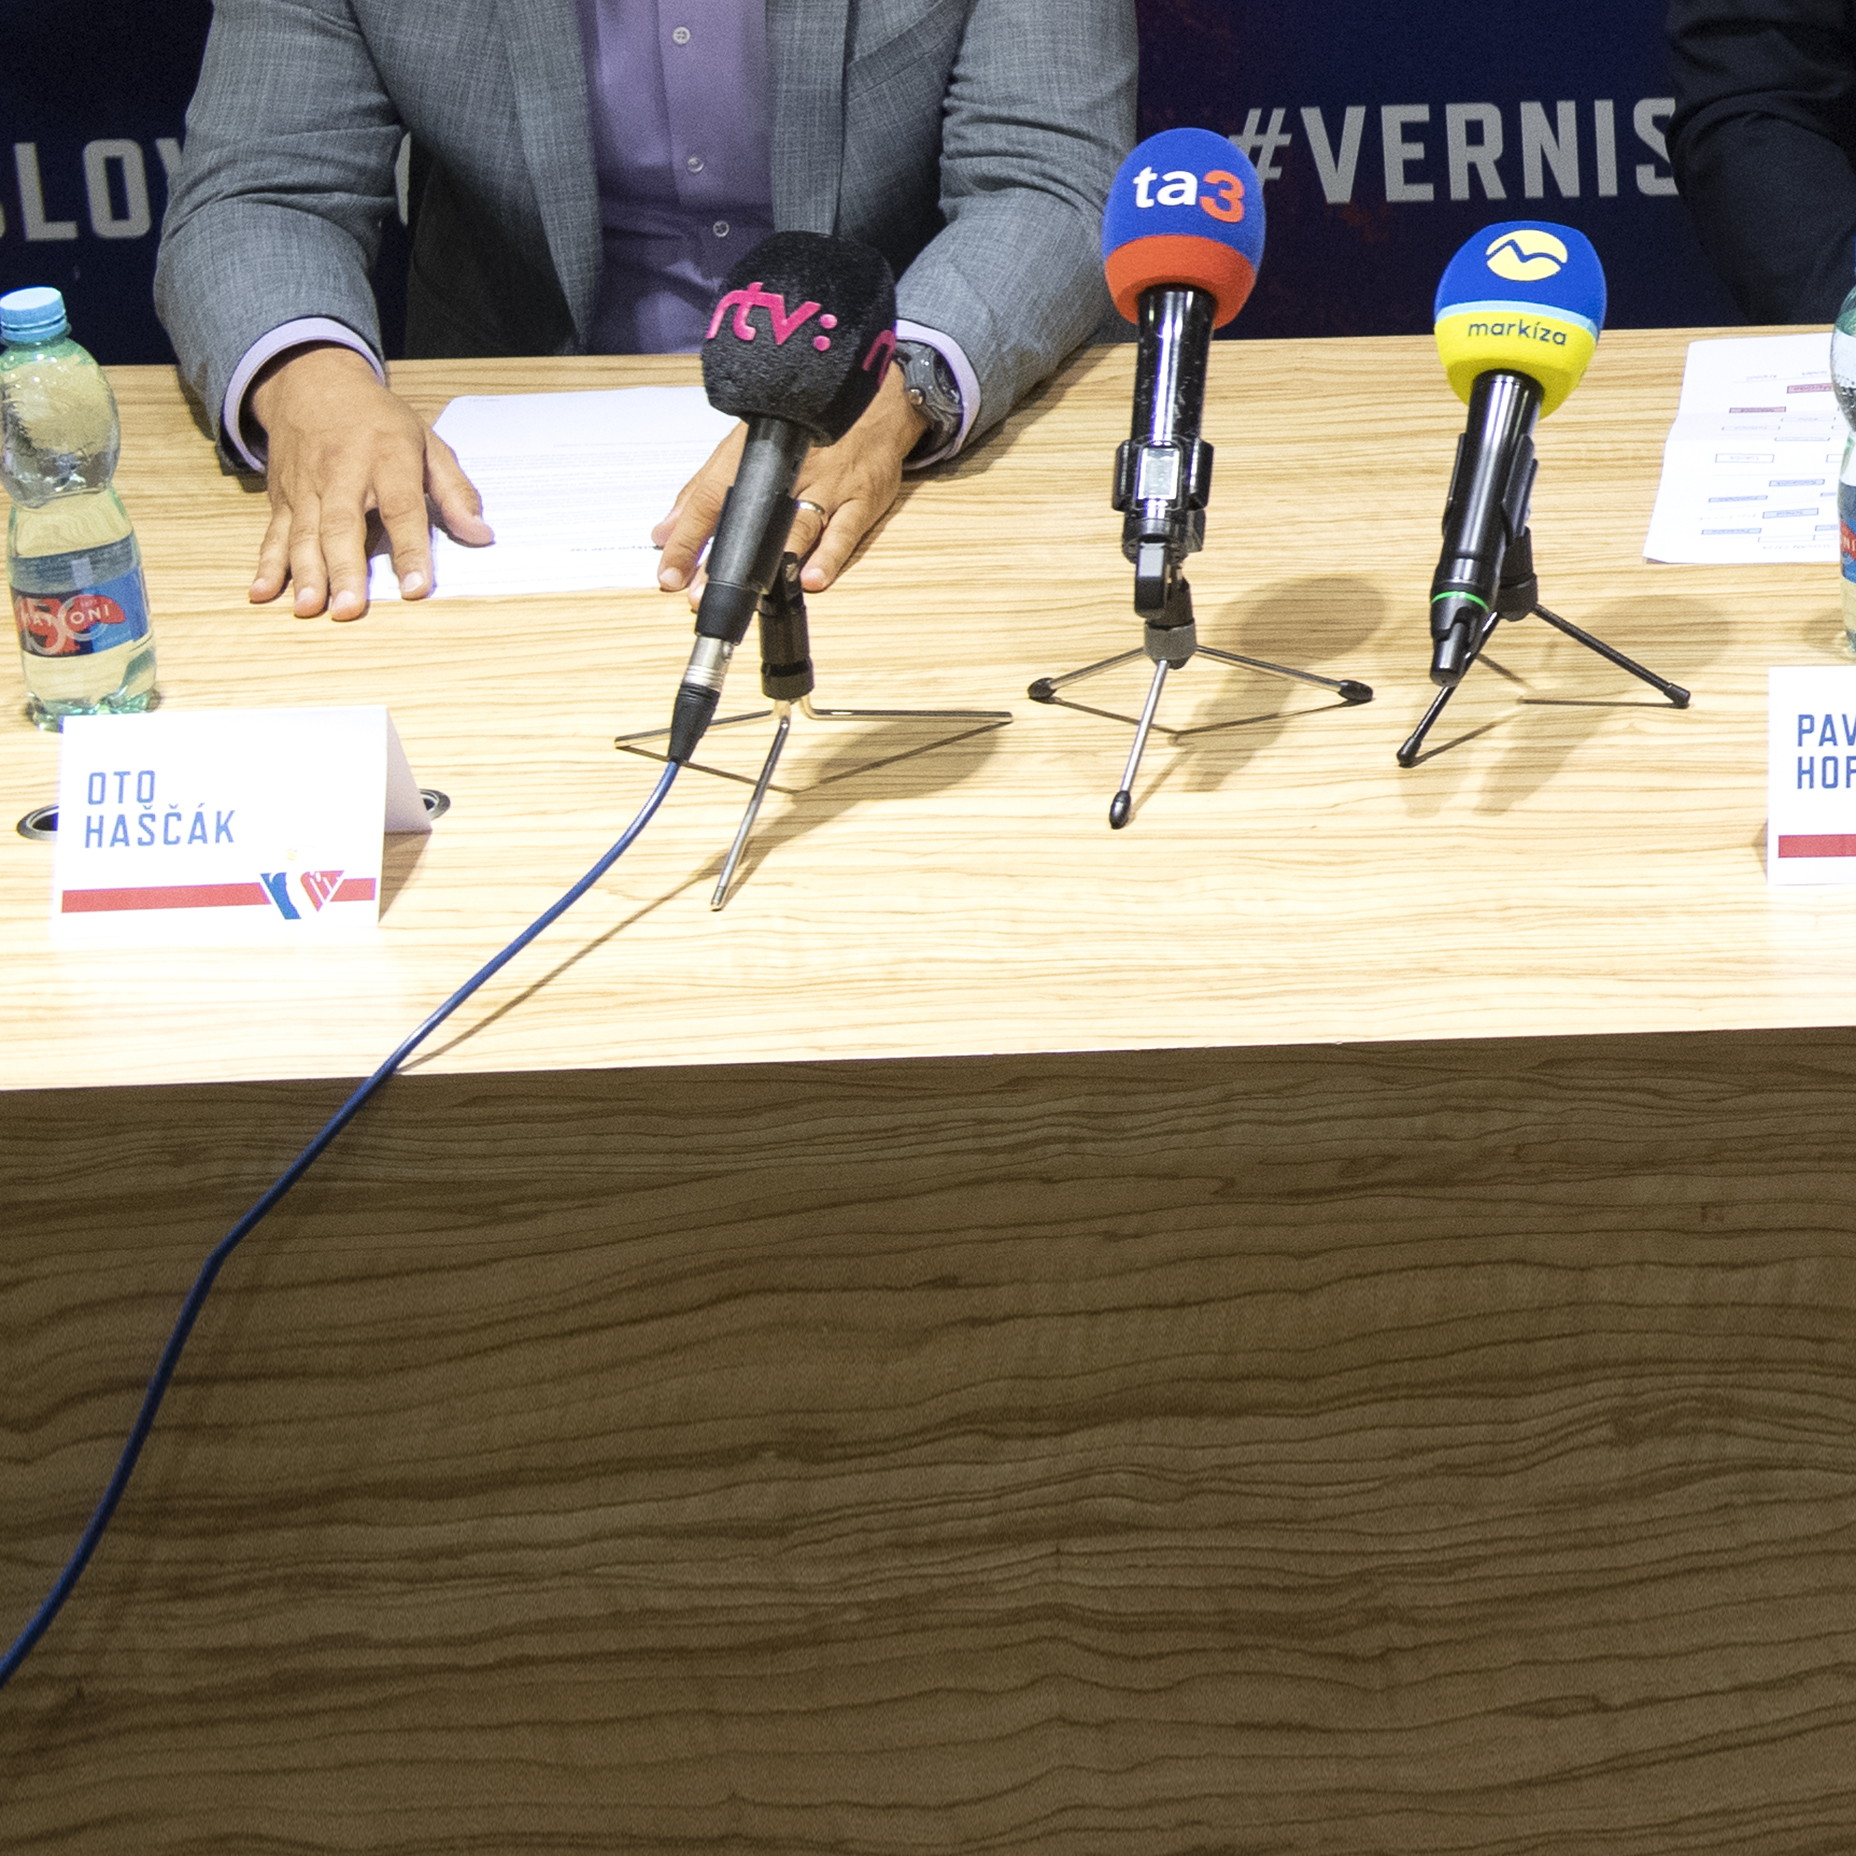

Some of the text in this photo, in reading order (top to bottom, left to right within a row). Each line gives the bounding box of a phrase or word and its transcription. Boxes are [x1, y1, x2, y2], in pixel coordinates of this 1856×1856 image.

[1132, 164, 1246, 225] ta3
[1466, 315, 1568, 348] markíza
[87, 770, 155, 810] OTO
[85, 805, 234, 848] HAŠČÁK
